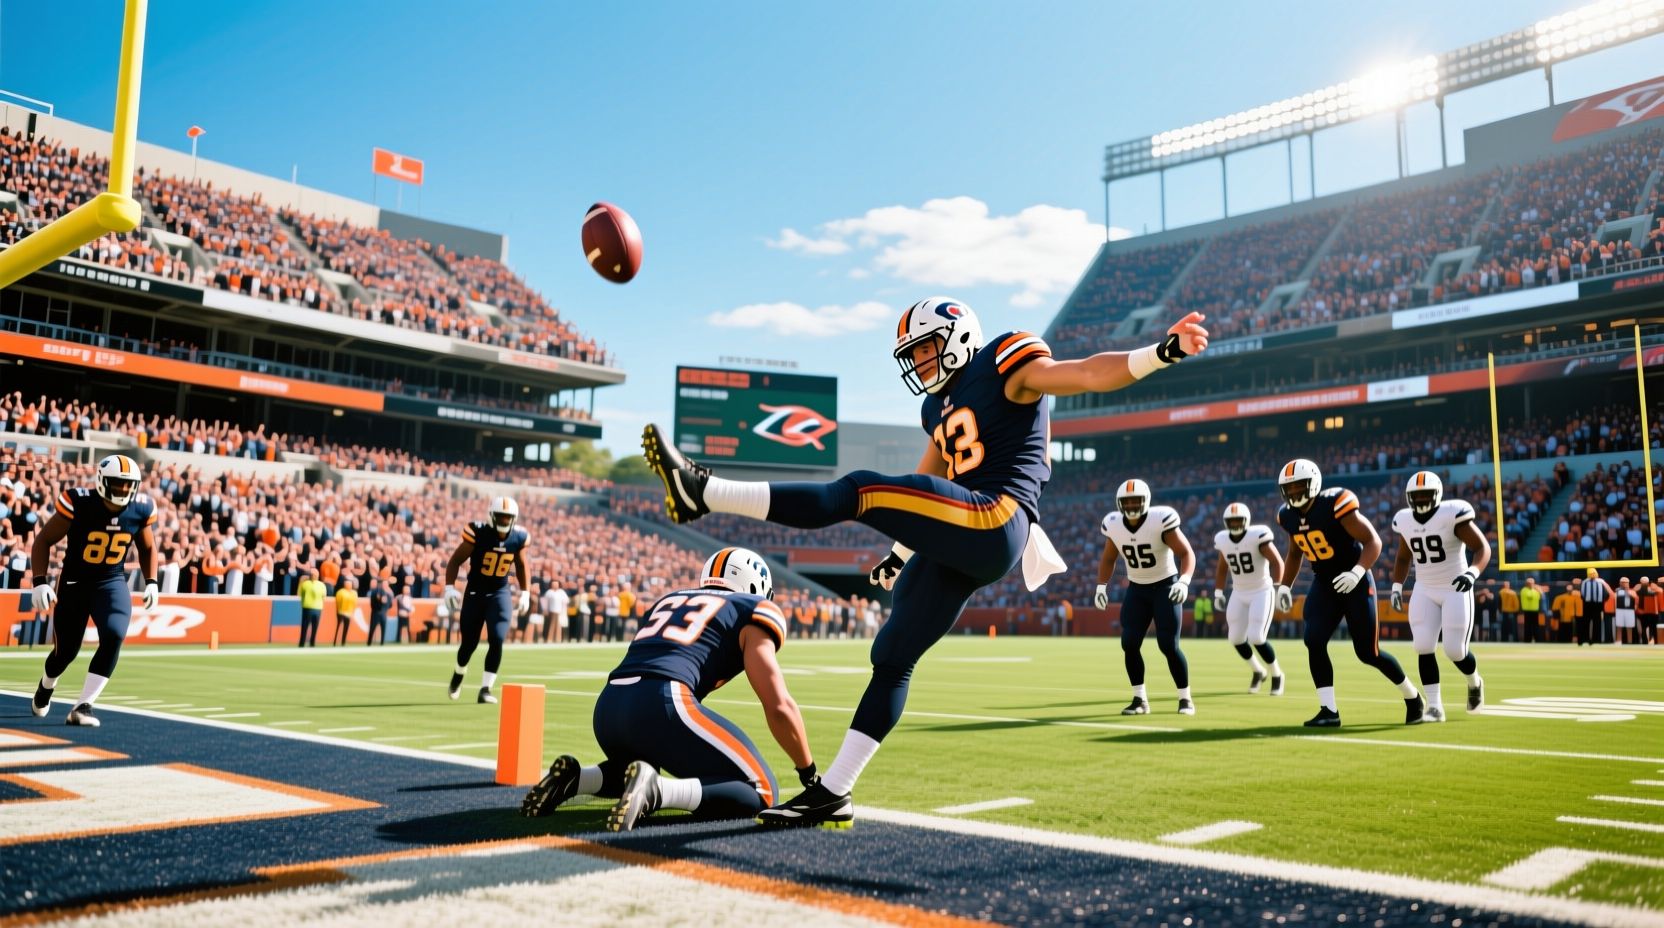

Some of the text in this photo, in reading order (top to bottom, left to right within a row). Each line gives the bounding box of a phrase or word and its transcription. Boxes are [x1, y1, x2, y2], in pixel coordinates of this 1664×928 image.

[82, 531, 132, 565] 85
[1122, 543, 1156, 568] 85
[1410, 534, 1446, 564] 99
[634, 595, 726, 646] 53
